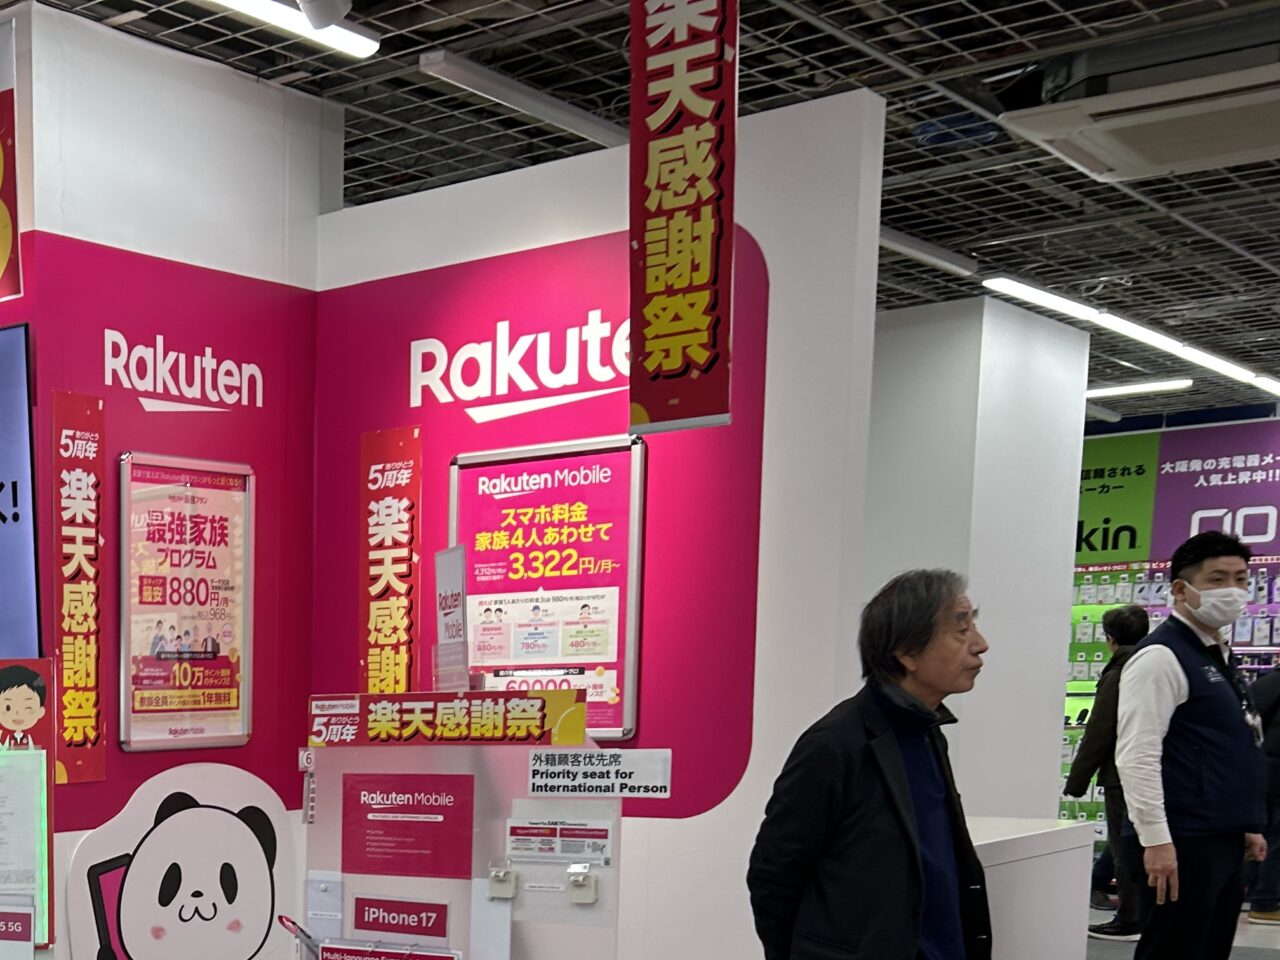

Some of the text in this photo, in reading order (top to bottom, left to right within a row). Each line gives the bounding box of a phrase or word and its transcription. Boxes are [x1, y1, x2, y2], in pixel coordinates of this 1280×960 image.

[103, 328, 263, 412] Rakuten
[60, 429, 98, 460] 5周年
[368, 462, 410, 490] 5周年
[478, 464, 612, 500] Rakuten Mobile
[1080, 483, 1124, 495] ーカー
[500, 501, 588, 528] スマホ料金
[146, 510, 229, 547] 最強家族
[474, 522, 613, 551] 家族4人あわせて
[157, 548, 217, 569] プログラム
[170, 576, 209, 606] 880
[367, 496, 412, 693] 楽天感謝
[439, 592, 461, 617] Rakuten
[60, 468, 99, 744] 楽天感謝祭
[168, 727, 189, 737] Rakuten
[310, 717, 359, 743] 5周年
[367, 697, 545, 741] 楽天感謝祭
[531, 782, 667, 794] International Person
[532, 769, 634, 781] Priority seat for
[360, 790, 454, 808] Rakuten Mobile
[6, 920, 22, 932] 5G
[364, 907, 437, 927] iPhone 17
